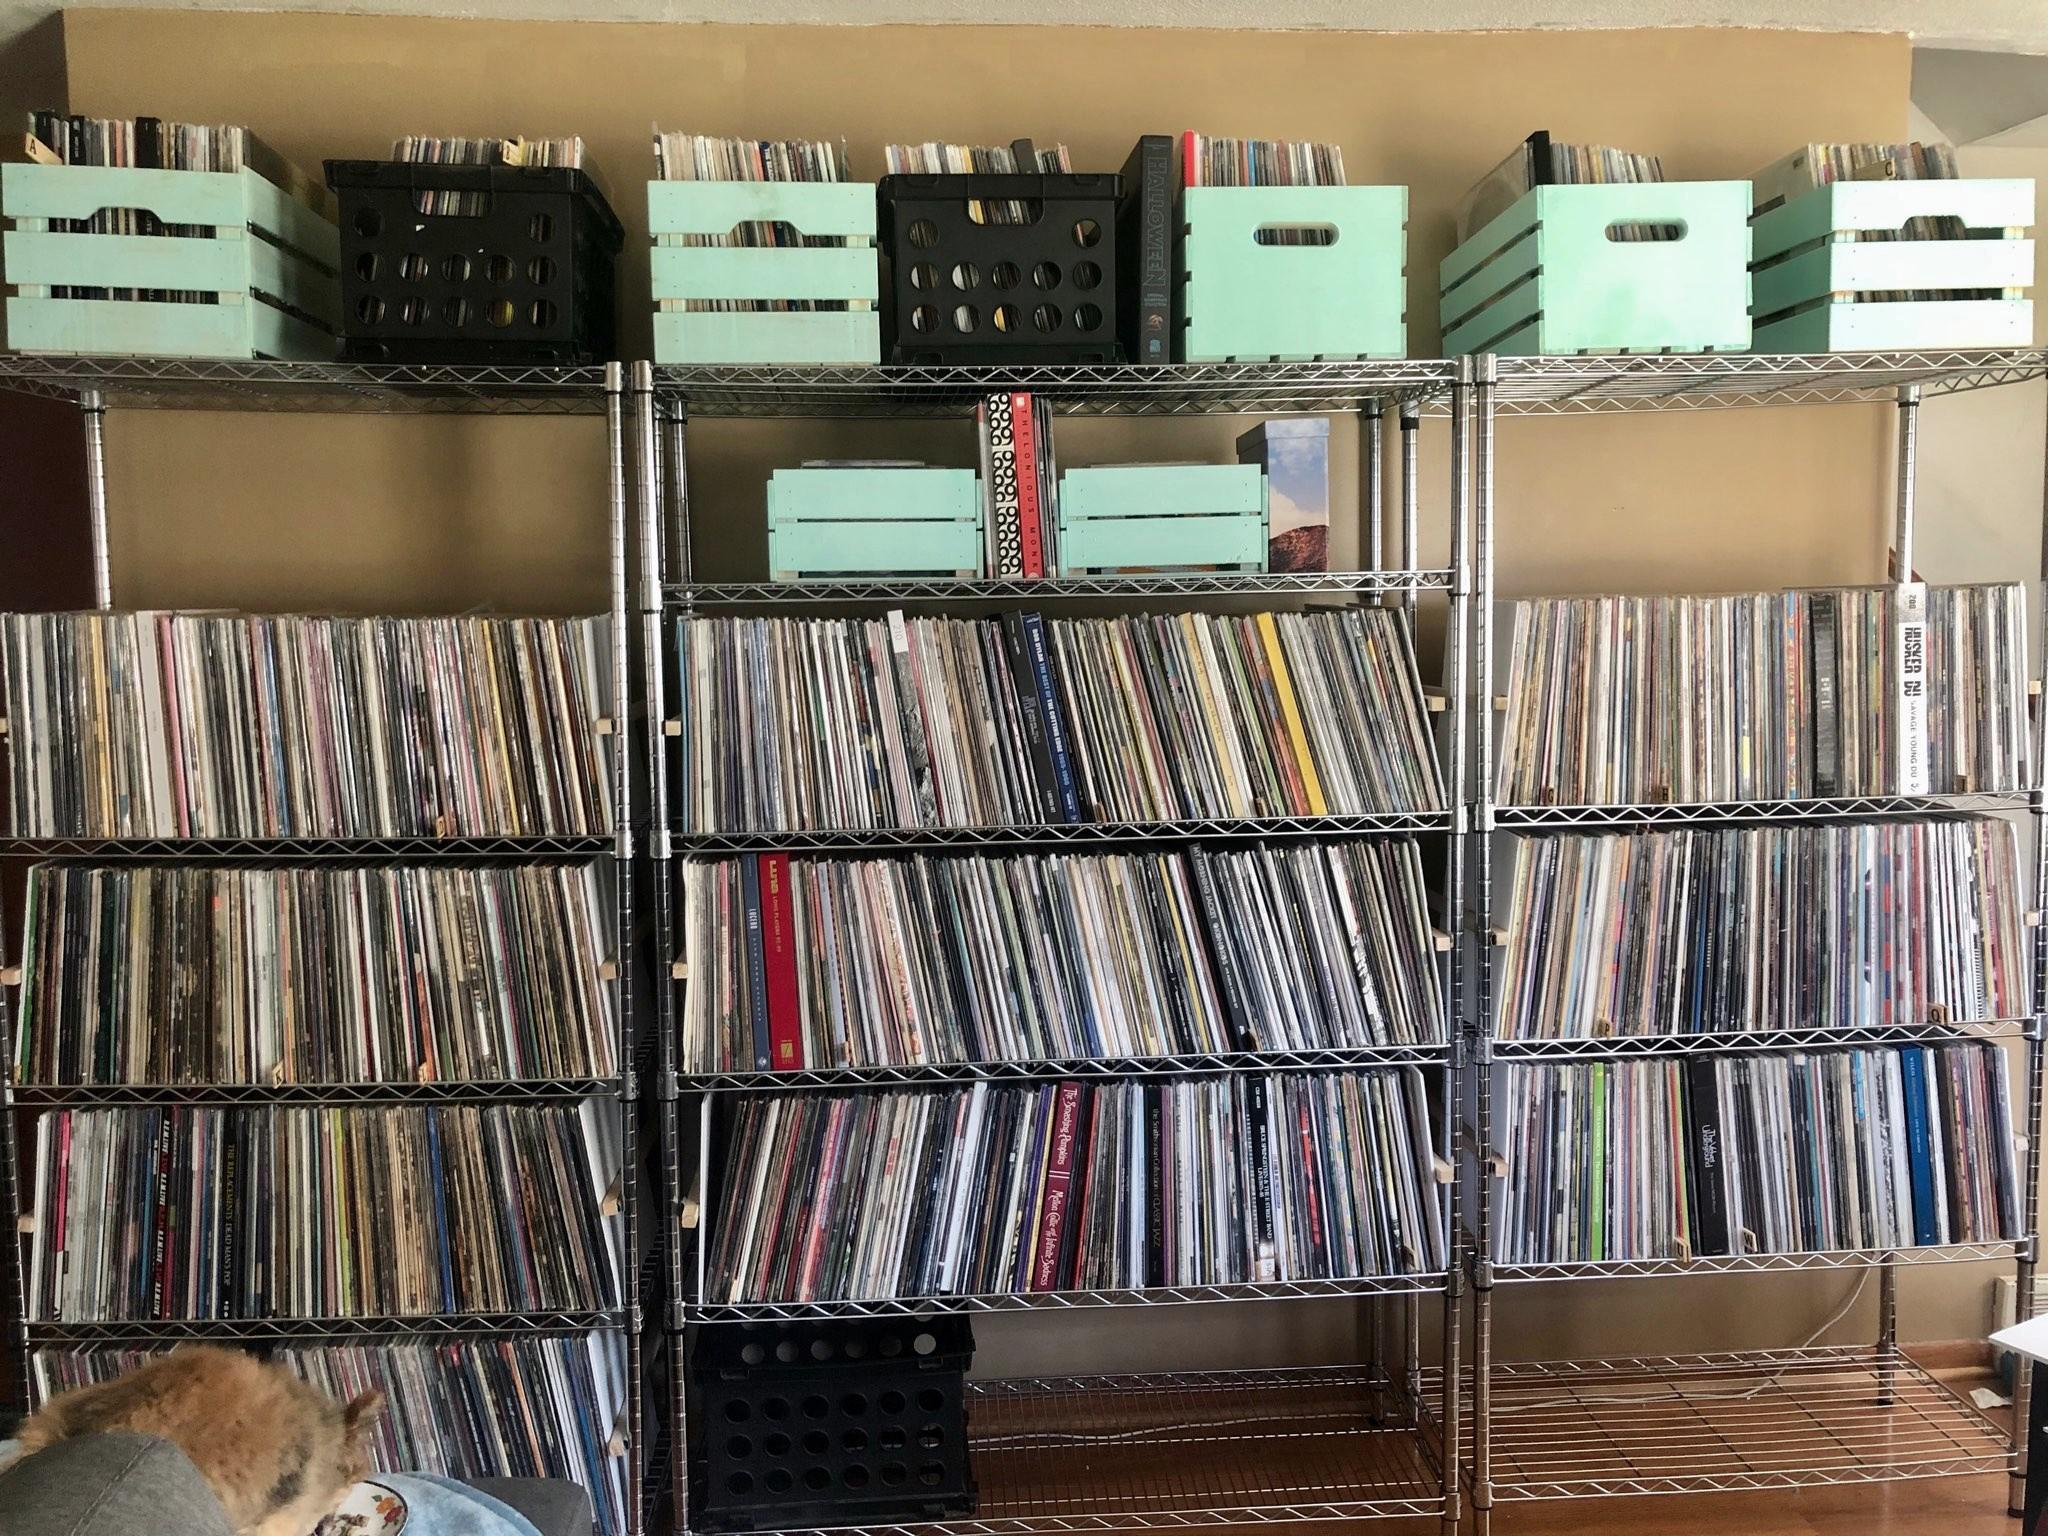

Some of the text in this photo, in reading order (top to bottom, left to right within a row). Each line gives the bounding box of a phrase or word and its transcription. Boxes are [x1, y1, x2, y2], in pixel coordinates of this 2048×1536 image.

[29, 138, 38, 155] A
[1885, 161, 1893, 177] C
[1144, 157, 1168, 287] HALLOWEEN
[1021, 410, 1038, 569] THELONIOUS MONK
[1035, 642, 1045, 662] DYLAN
[1904, 627, 1922, 674] HUSKER
[1038, 662, 1047, 674] THE
[1040, 675, 1049, 690] BEST
[1904, 681, 1921, 697] DU
[1045, 690, 1051, 698] OF
[1047, 699, 1055, 710] THE
[1049, 710, 1060, 737] CUTTING
[1054, 737, 1062, 753] EDGE
[1910, 766, 1917, 778] DU
[1192, 846, 1202, 858] MY
[1196, 859, 1212, 895] MORNING
[748, 909, 759, 929] LUCERO
[1212, 922, 1229, 966] OKONOKOS
[1931, 1008, 1942, 1023] Q
[1152, 1108, 1160, 1120] the
[1057, 1088, 1078, 1165] The Smashing Pumpkins
[1259, 1125, 1267, 1142] BRUCE
[1707, 1130, 1716, 1142] The
[227, 1144, 235, 1160] THE
[1701, 1125, 1711, 1168] Underground
[1707, 1141, 1716, 1164] Velvet
[1260, 1143, 1269, 1177] SPRINGSTEEN
[225, 1160, 234, 1220] REPLACEMENTS
[1048, 1190, 1064, 1211] Mellon
[1045, 1212, 1060, 1228] Collie
[224, 1223, 232, 1245] DEAD
[1151, 1227, 1160, 1247] JAZZ
[1044, 1238, 1057, 1259] Infinite
[223, 1271, 231, 1286] POP
[1039, 1256, 1055, 1286] Sadness
